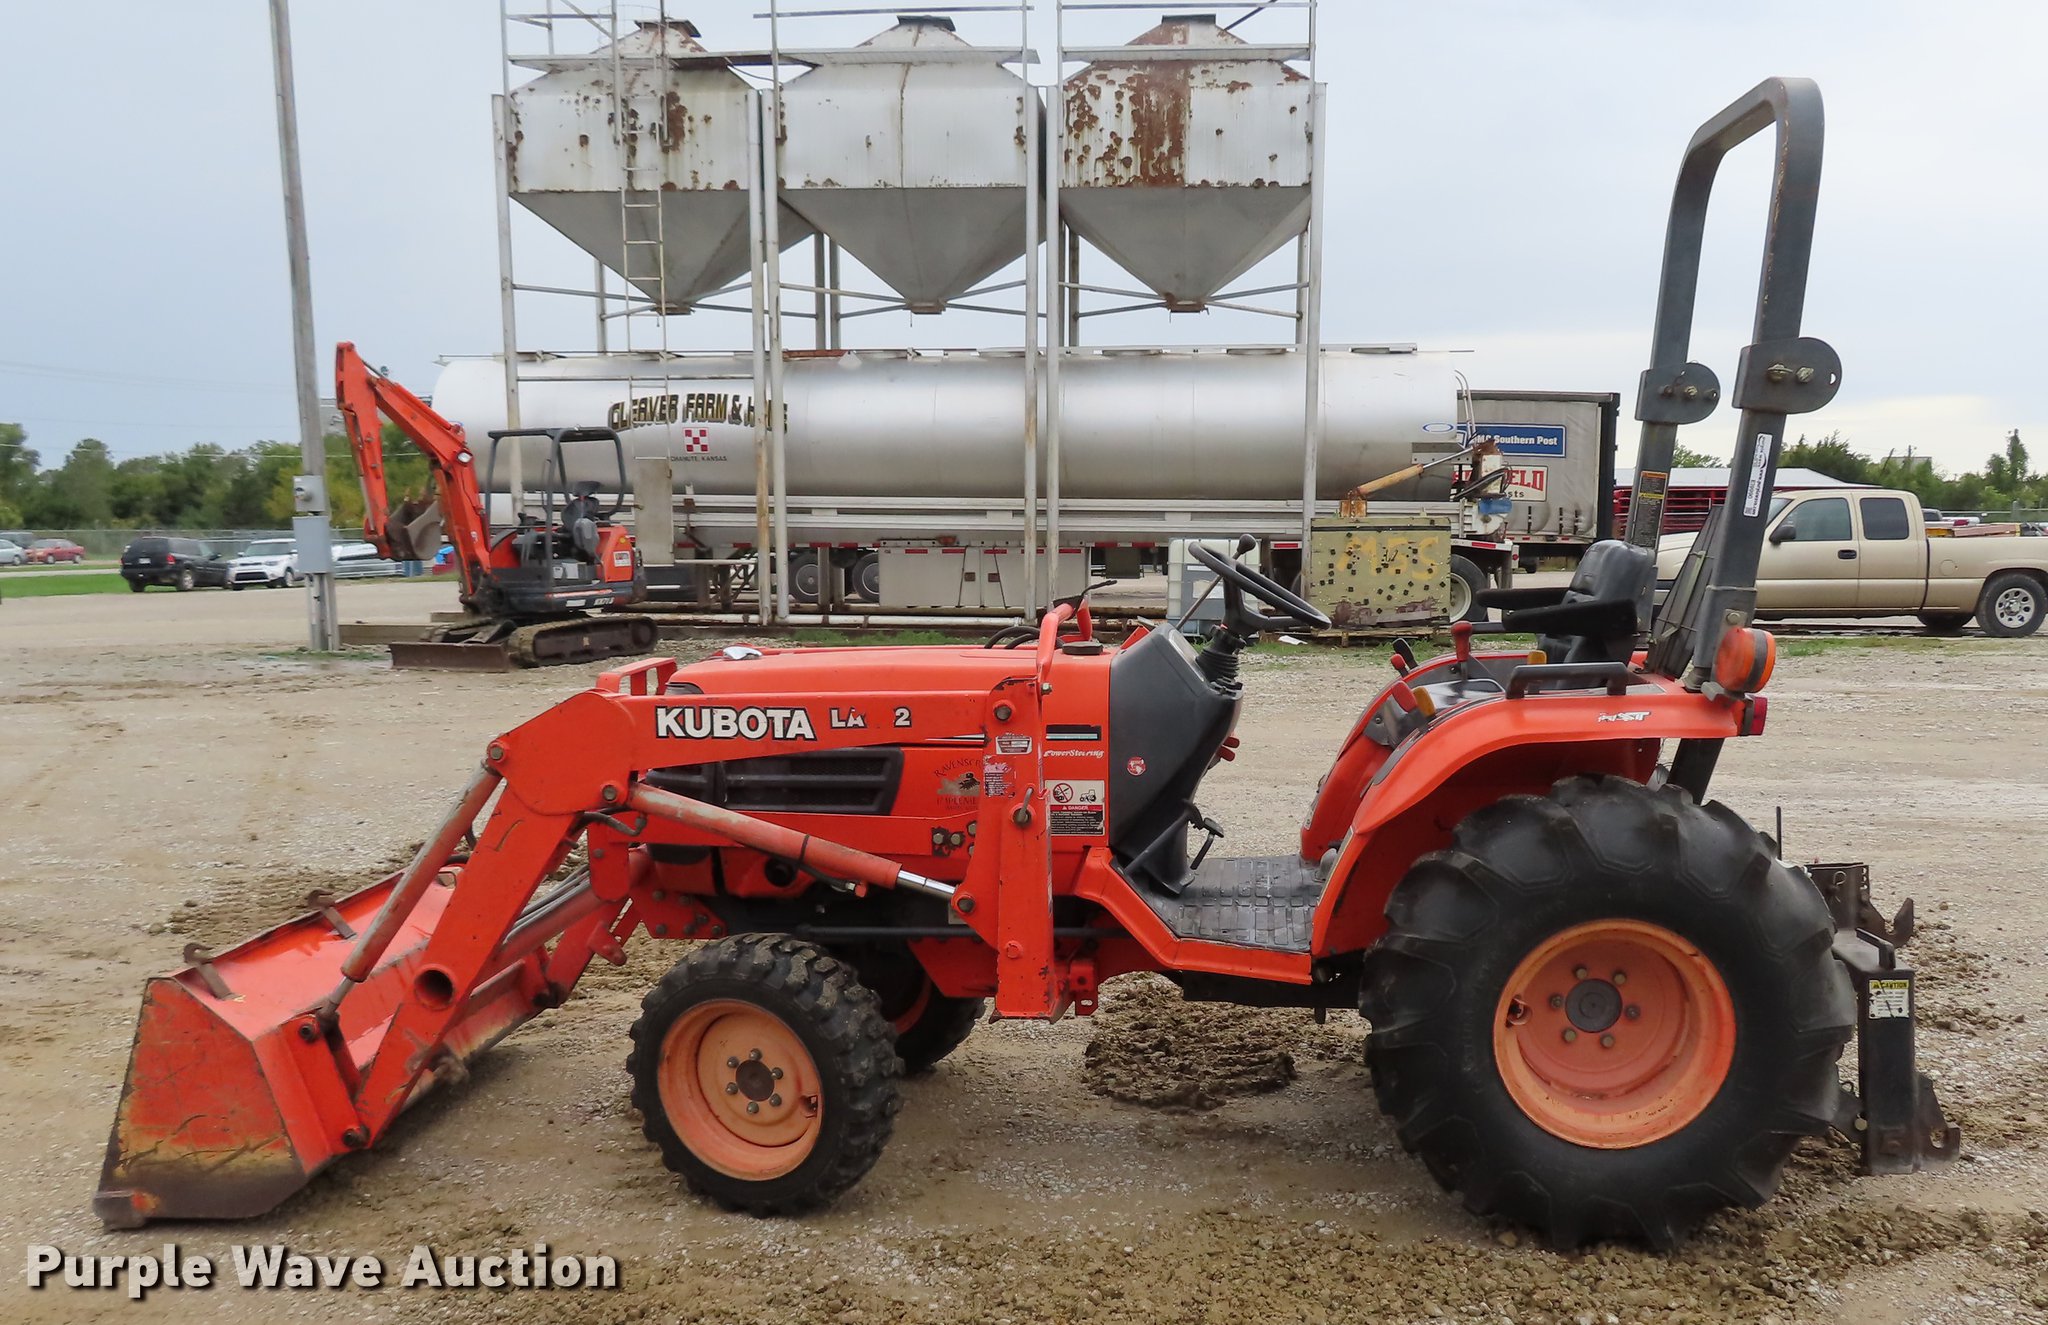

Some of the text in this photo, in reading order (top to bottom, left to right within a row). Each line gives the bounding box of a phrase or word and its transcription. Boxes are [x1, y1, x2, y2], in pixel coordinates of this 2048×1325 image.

[608, 394, 679, 432] CLEAVER
[682, 393, 729, 423] FARM
[728, 394, 743, 424] &
[1494, 434, 1535, 445] Southern
[1536, 436, 1558, 446] Post
[656, 706, 818, 741] KUBOTA
